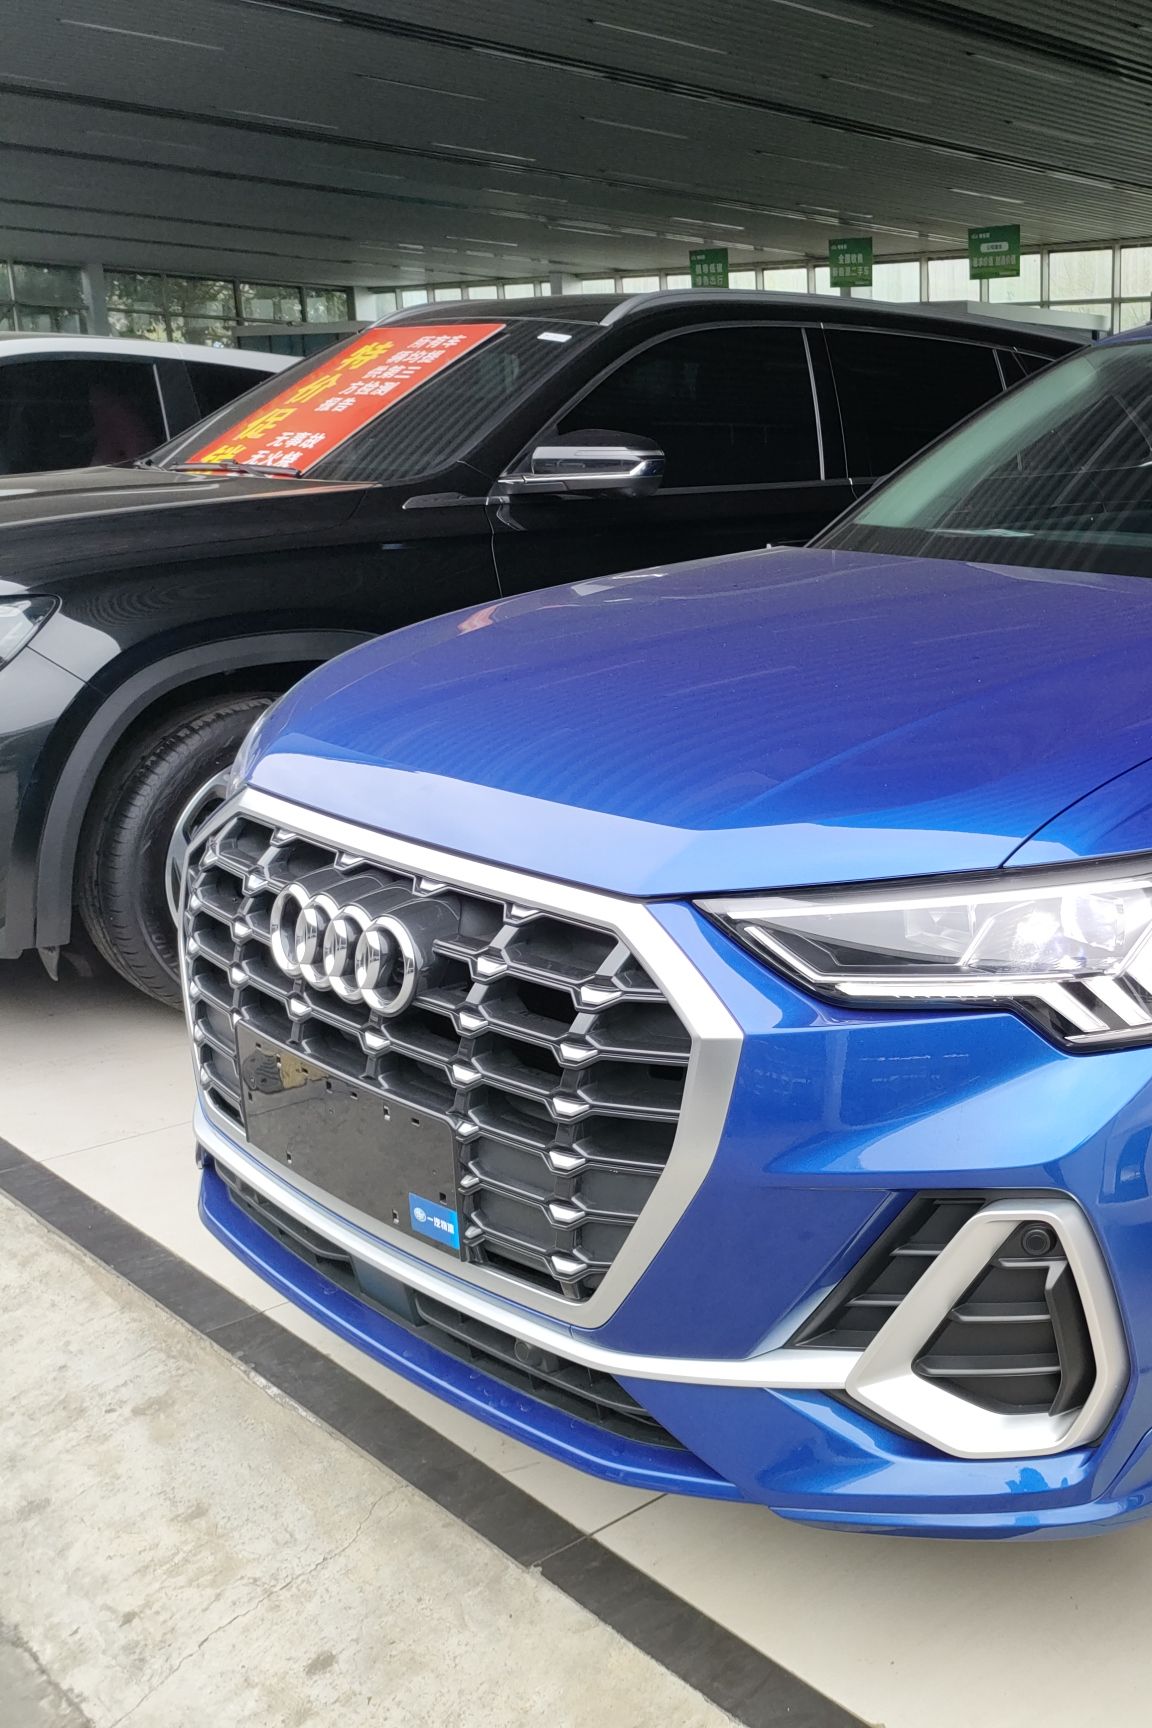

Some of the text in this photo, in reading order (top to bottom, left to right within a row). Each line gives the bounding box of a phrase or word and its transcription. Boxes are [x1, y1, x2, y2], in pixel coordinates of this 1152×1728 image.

[406, 334, 468, 349] 所有车
[338, 381, 401, 397] 方检测
[200, 341, 394, 464] 特价促销
[315, 397, 357, 413] 报告
[266, 432, 326, 449] 无事故
[243, 450, 303, 468] 无火烧
